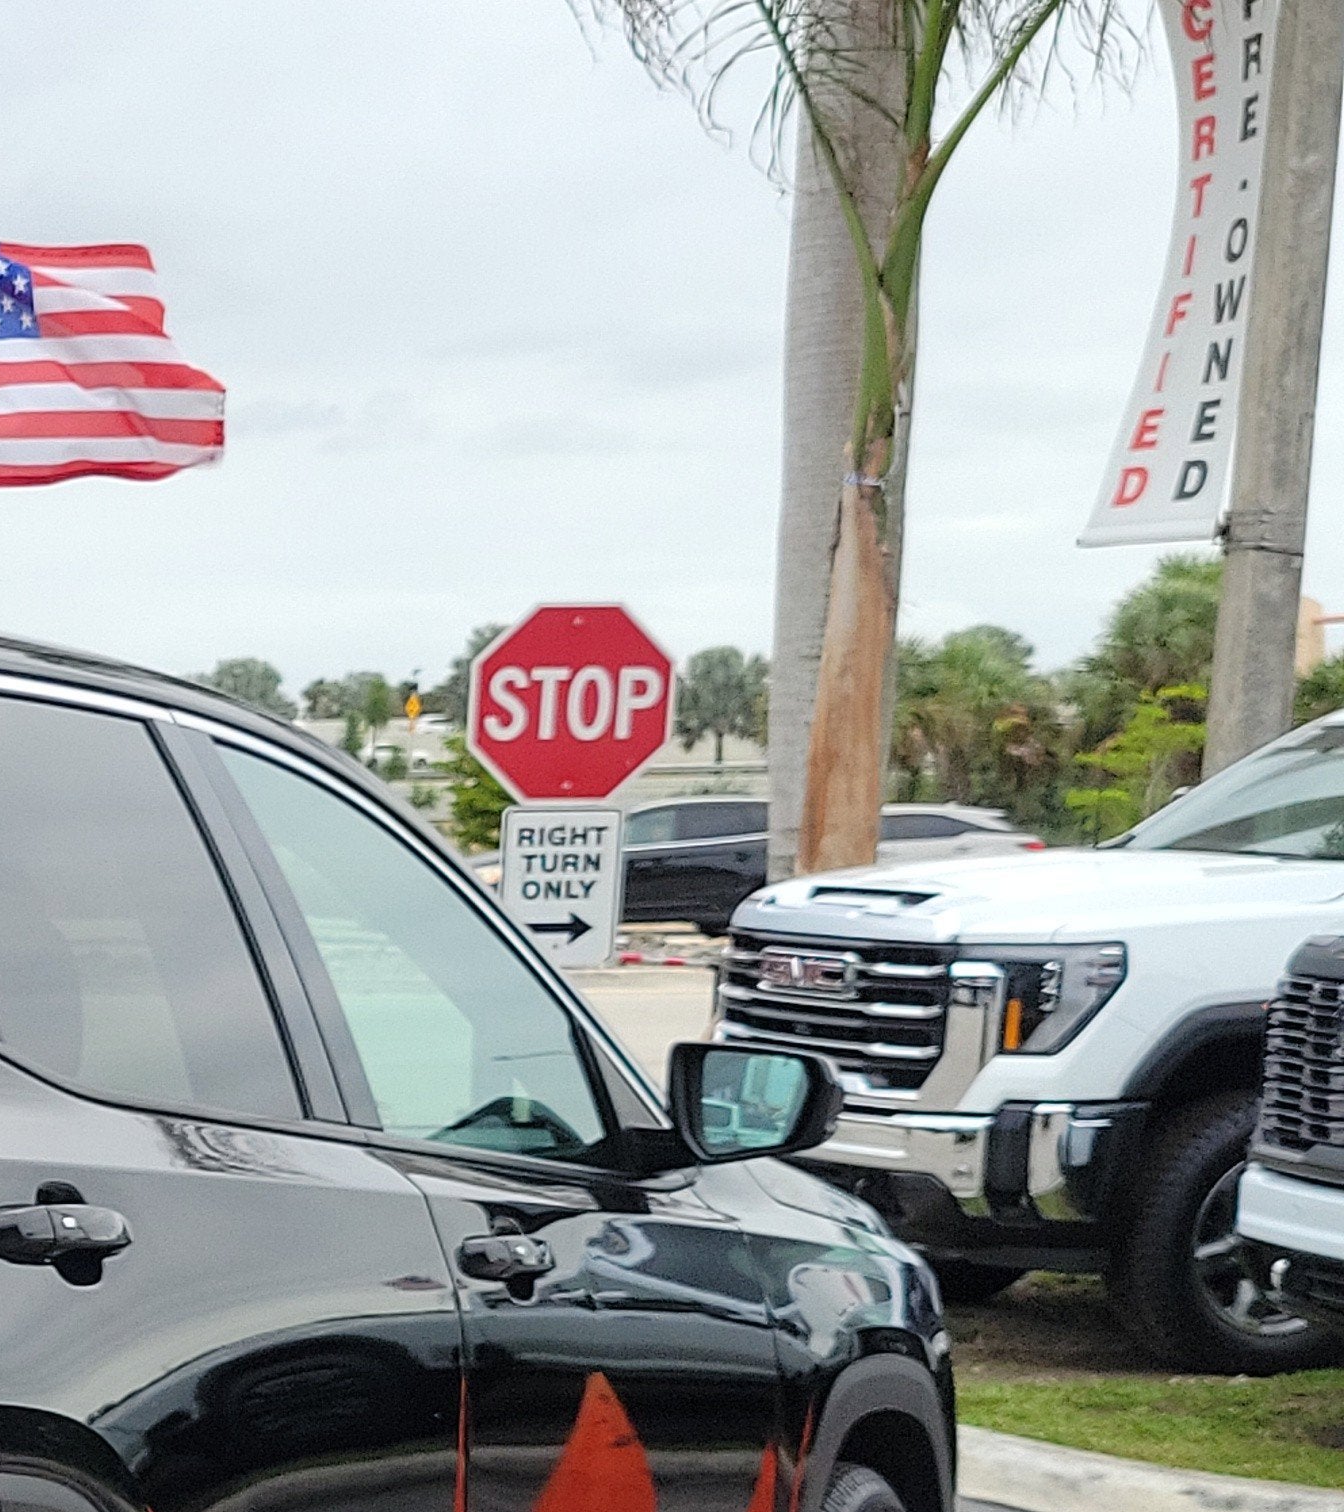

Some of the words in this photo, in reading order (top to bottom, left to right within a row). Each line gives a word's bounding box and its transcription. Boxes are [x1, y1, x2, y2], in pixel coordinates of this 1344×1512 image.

[1113, 0, 1216, 507] CERTIFIED
[482, 664, 666, 743] STOP
[516, 825, 609, 847] RIGHT
[523, 853, 602, 873] TURN
[521, 880, 596, 900] ONLY
